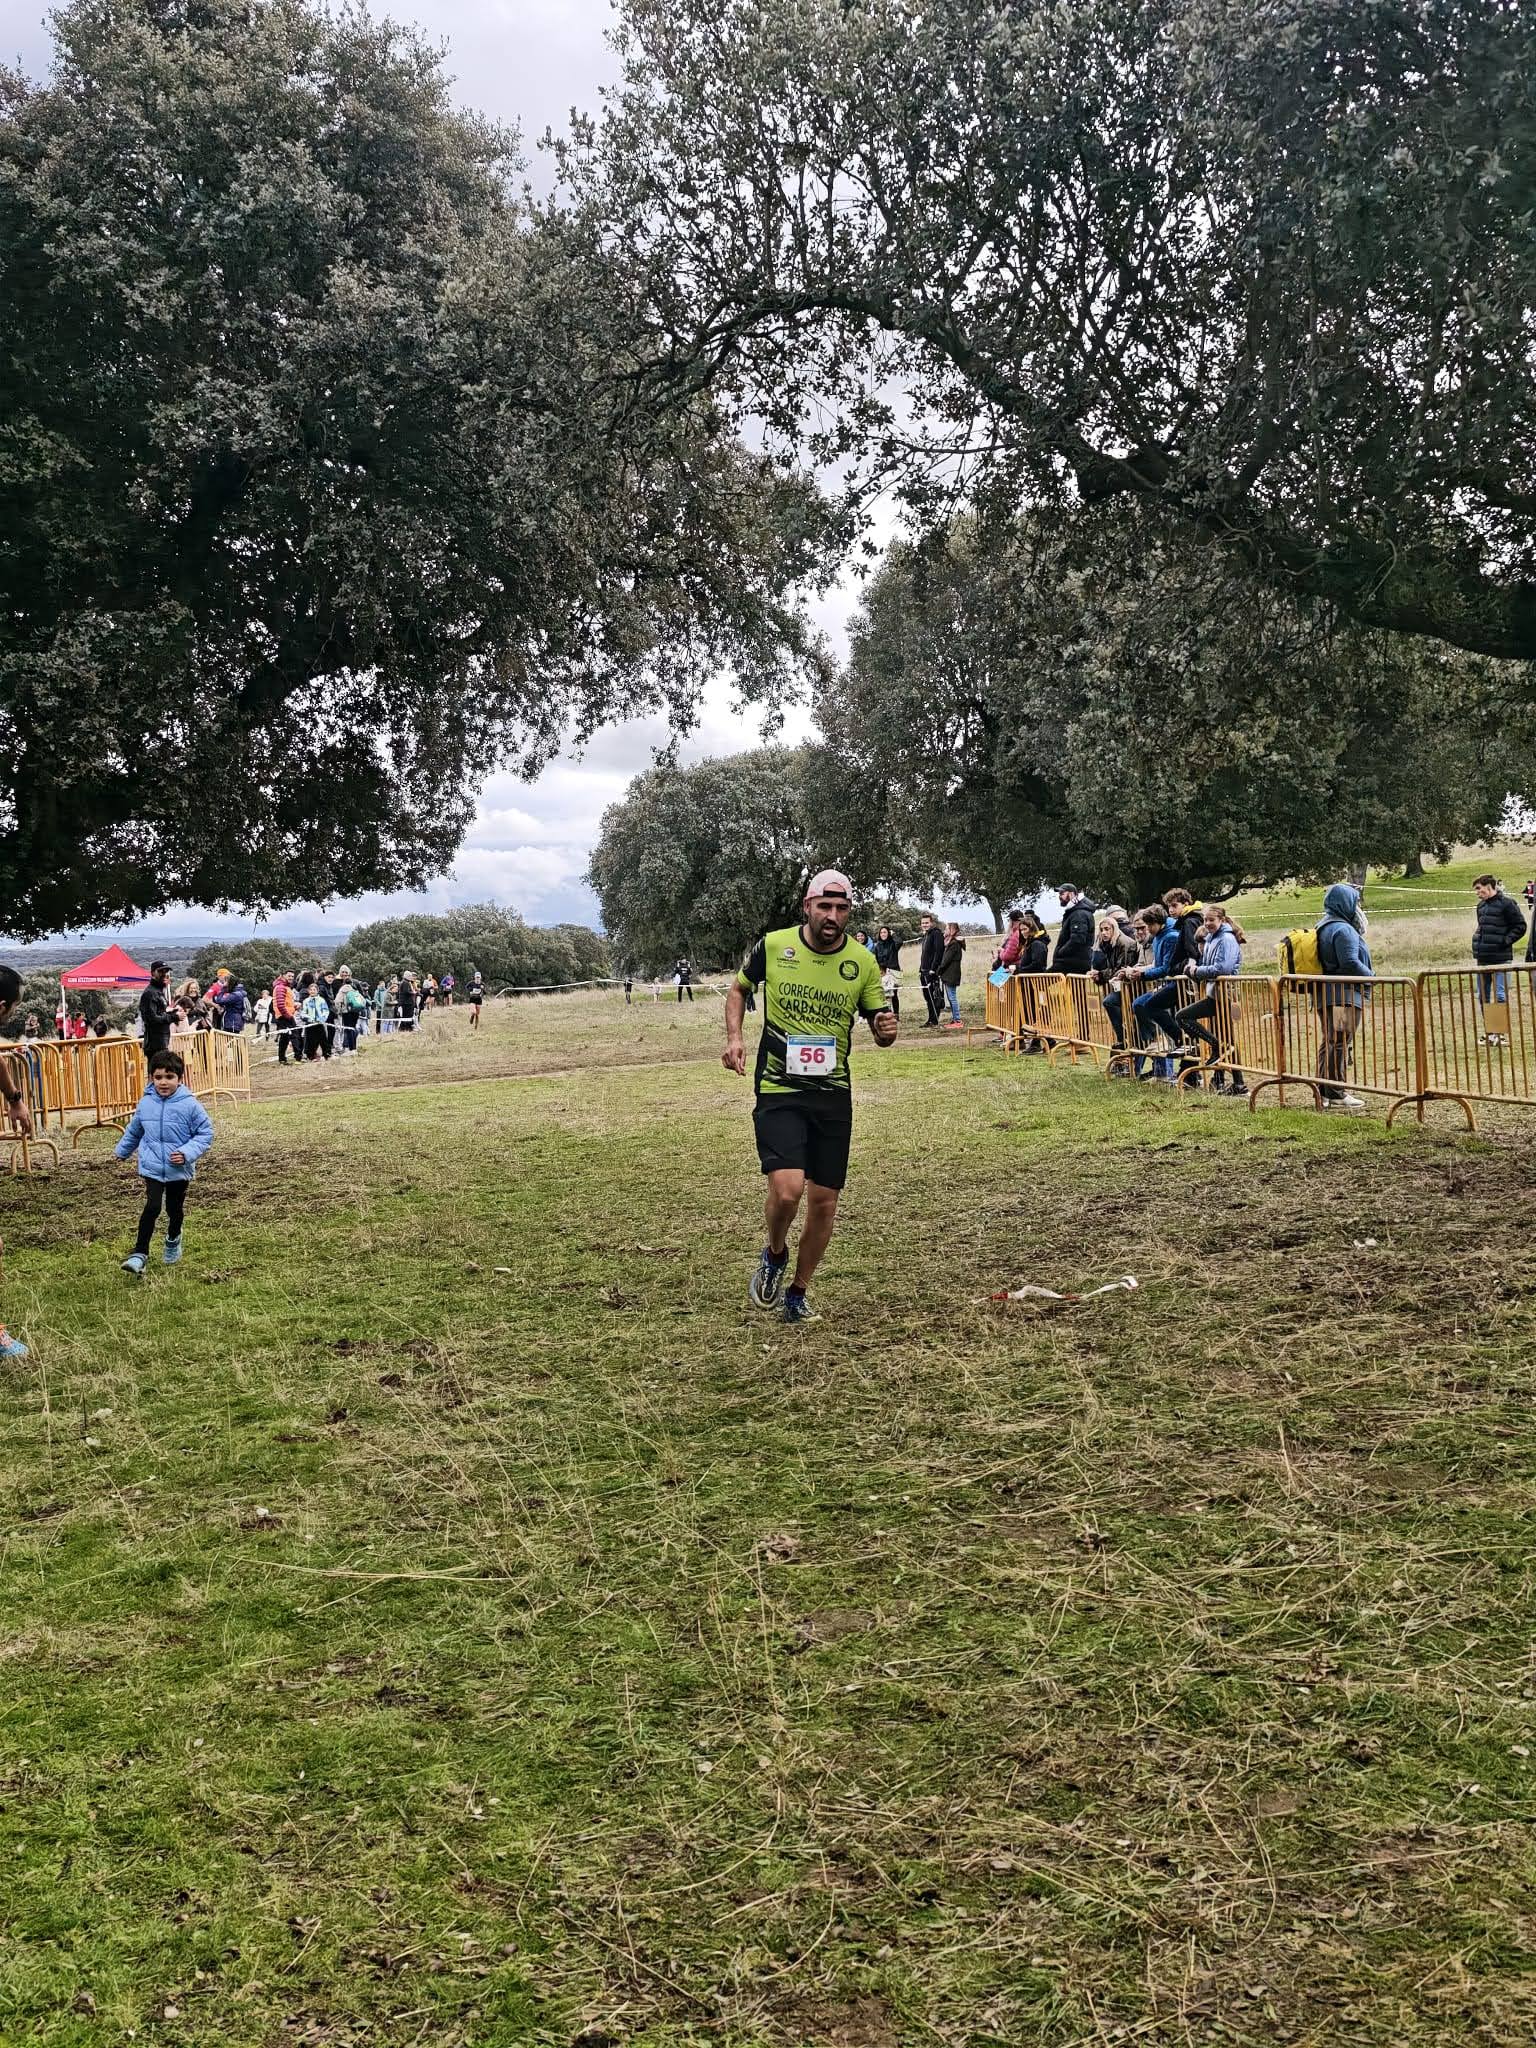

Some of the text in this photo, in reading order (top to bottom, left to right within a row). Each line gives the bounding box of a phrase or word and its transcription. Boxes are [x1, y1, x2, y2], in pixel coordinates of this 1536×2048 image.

[779, 982, 848, 1007] CORRECAMINOS
[780, 997, 842, 1020] CARBAJOSA
[800, 1047, 825, 1064] 56
